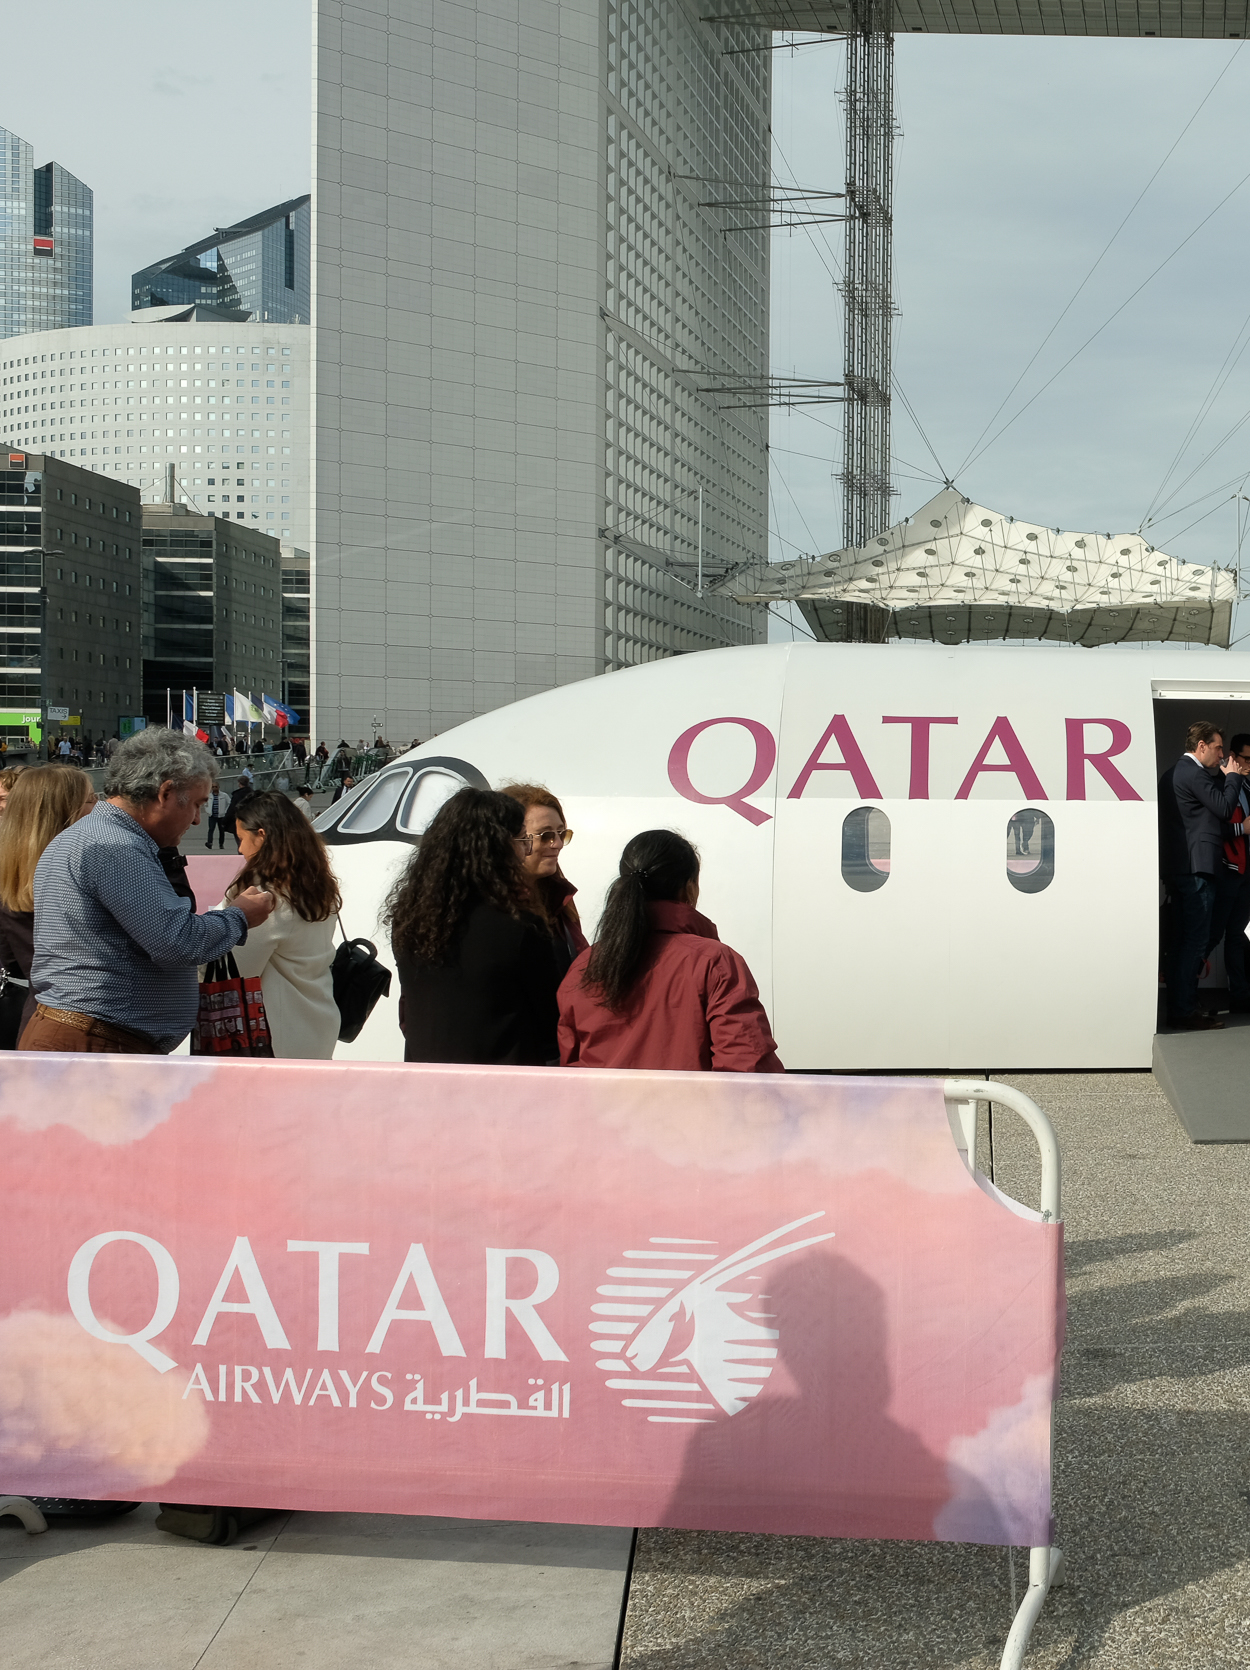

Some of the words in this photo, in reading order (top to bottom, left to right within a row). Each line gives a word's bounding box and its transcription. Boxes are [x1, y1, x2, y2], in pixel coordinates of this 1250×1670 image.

[49, 707, 68, 715] TAXIS
[667, 713, 1145, 827] QATAR
[67, 1230, 570, 1375] QATAR
[181, 1363, 394, 1411] AIRWAYS
[403, 1372, 571, 1423] القطرية
